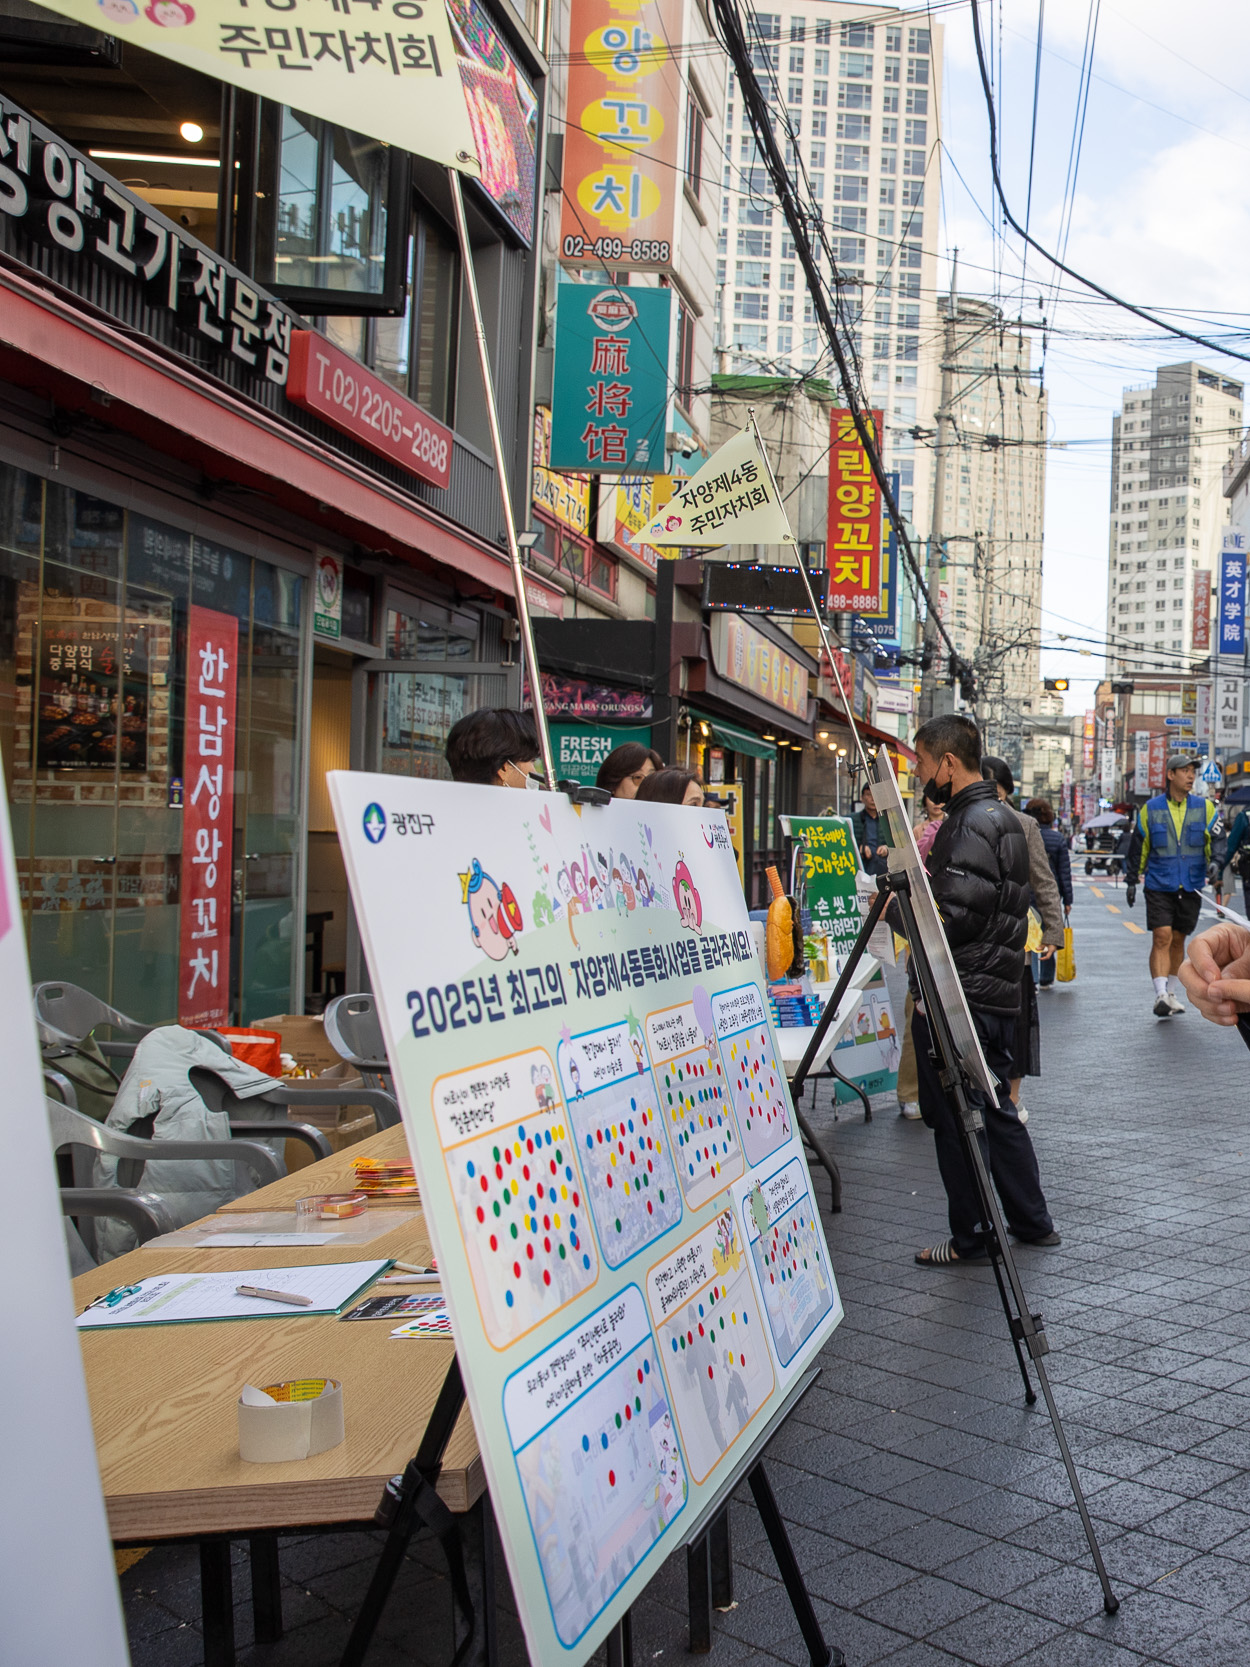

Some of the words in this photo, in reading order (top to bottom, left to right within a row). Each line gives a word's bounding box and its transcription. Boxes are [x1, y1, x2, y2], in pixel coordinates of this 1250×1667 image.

[219, 24, 443, 77] 주민자치회
[563, 236, 670, 263] 02-499-8588
[679, 459, 759, 509] 자양제4동
[690, 484, 770, 535] 주민자치회
[827, 594, 878, 609] 498-8886
[1223, 561, 1243, 641] 英才学院
[49, 644, 93, 658] 다양한
[49, 658, 93, 671] 중국식
[1221, 679, 1239, 729] 고시텔
[560, 736, 612, 750] FRESH
[187, 641, 230, 999] 한남성왕꼬치
[391, 813, 436, 836] 광진구
[406, 974, 506, 1039] 2025년
[506, 963, 568, 1016] 최고의
[700, 929, 752, 976] 골라주세요!
